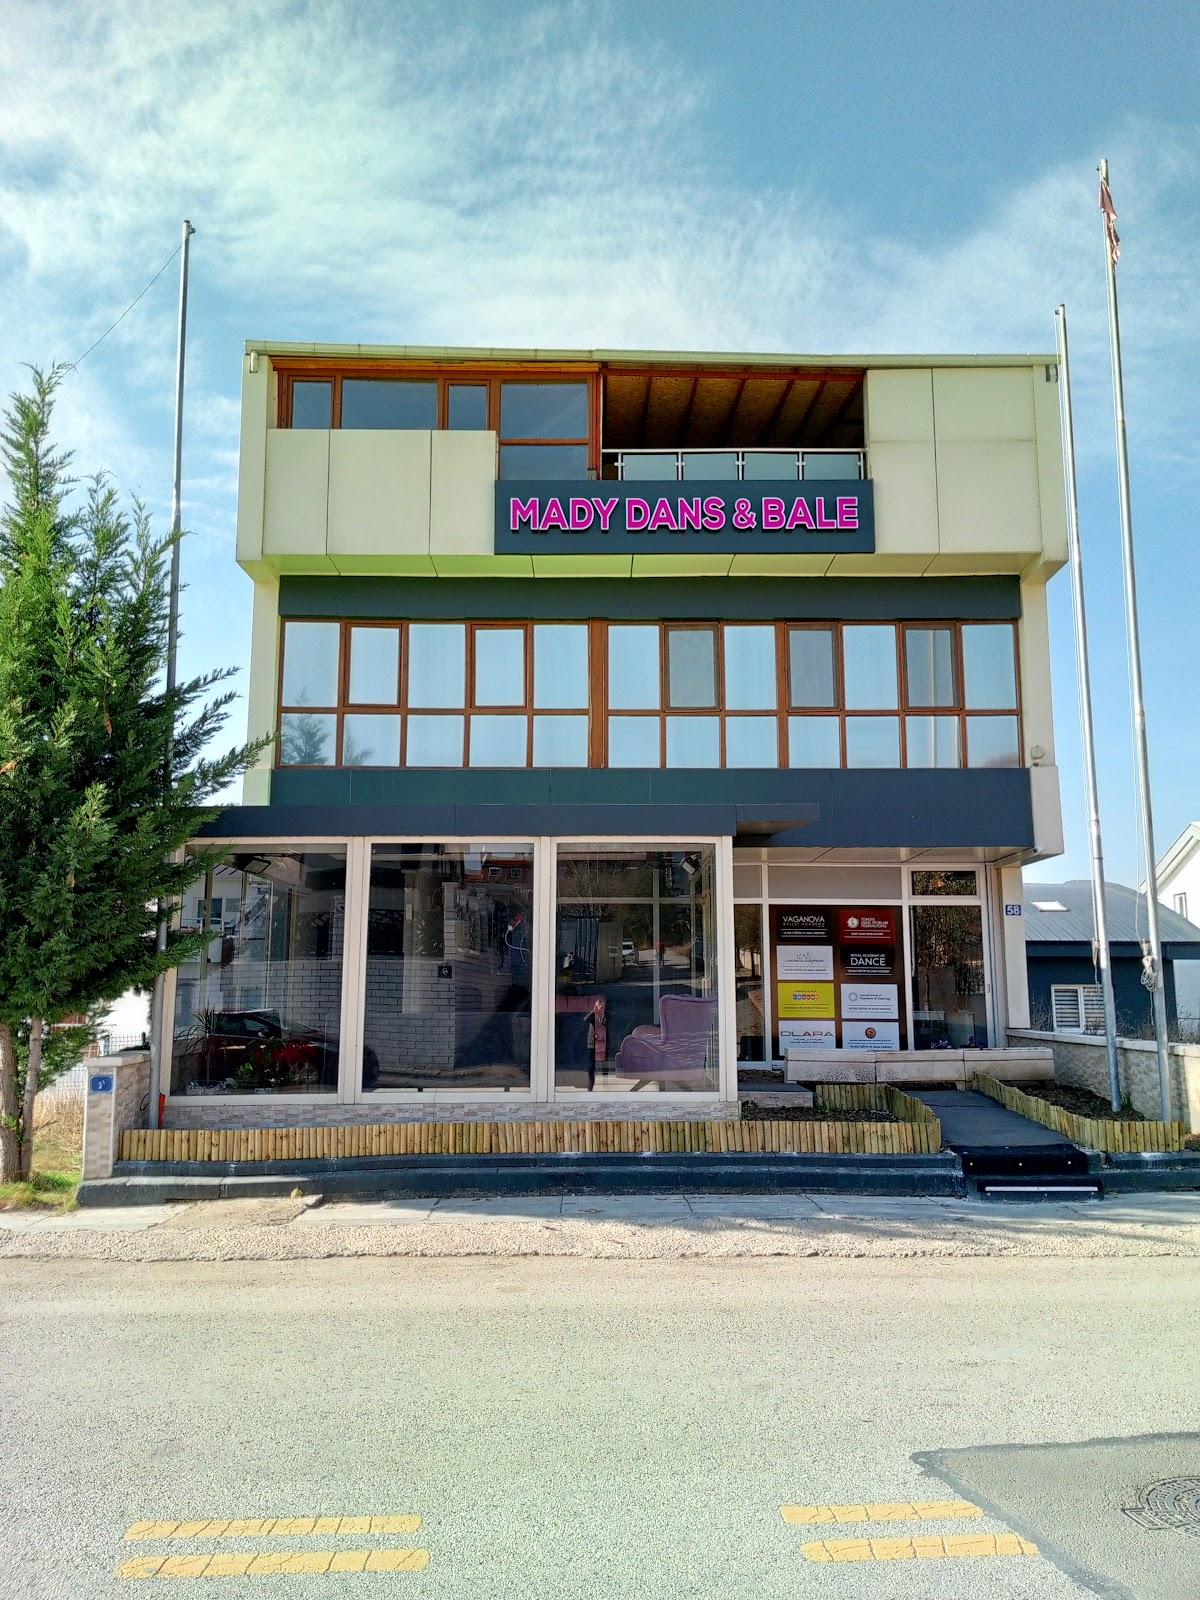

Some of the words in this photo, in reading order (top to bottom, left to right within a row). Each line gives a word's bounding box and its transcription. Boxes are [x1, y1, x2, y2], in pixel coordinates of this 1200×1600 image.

[510, 497, 619, 531] MADY
[625, 497, 726, 531] DANS
[732, 498, 757, 529] &
[762, 496, 859, 530] BALE
[1006, 905, 1020, 915] 58
[782, 915, 825, 923] VAGANOVA
[850, 957, 886, 966] DANCE
